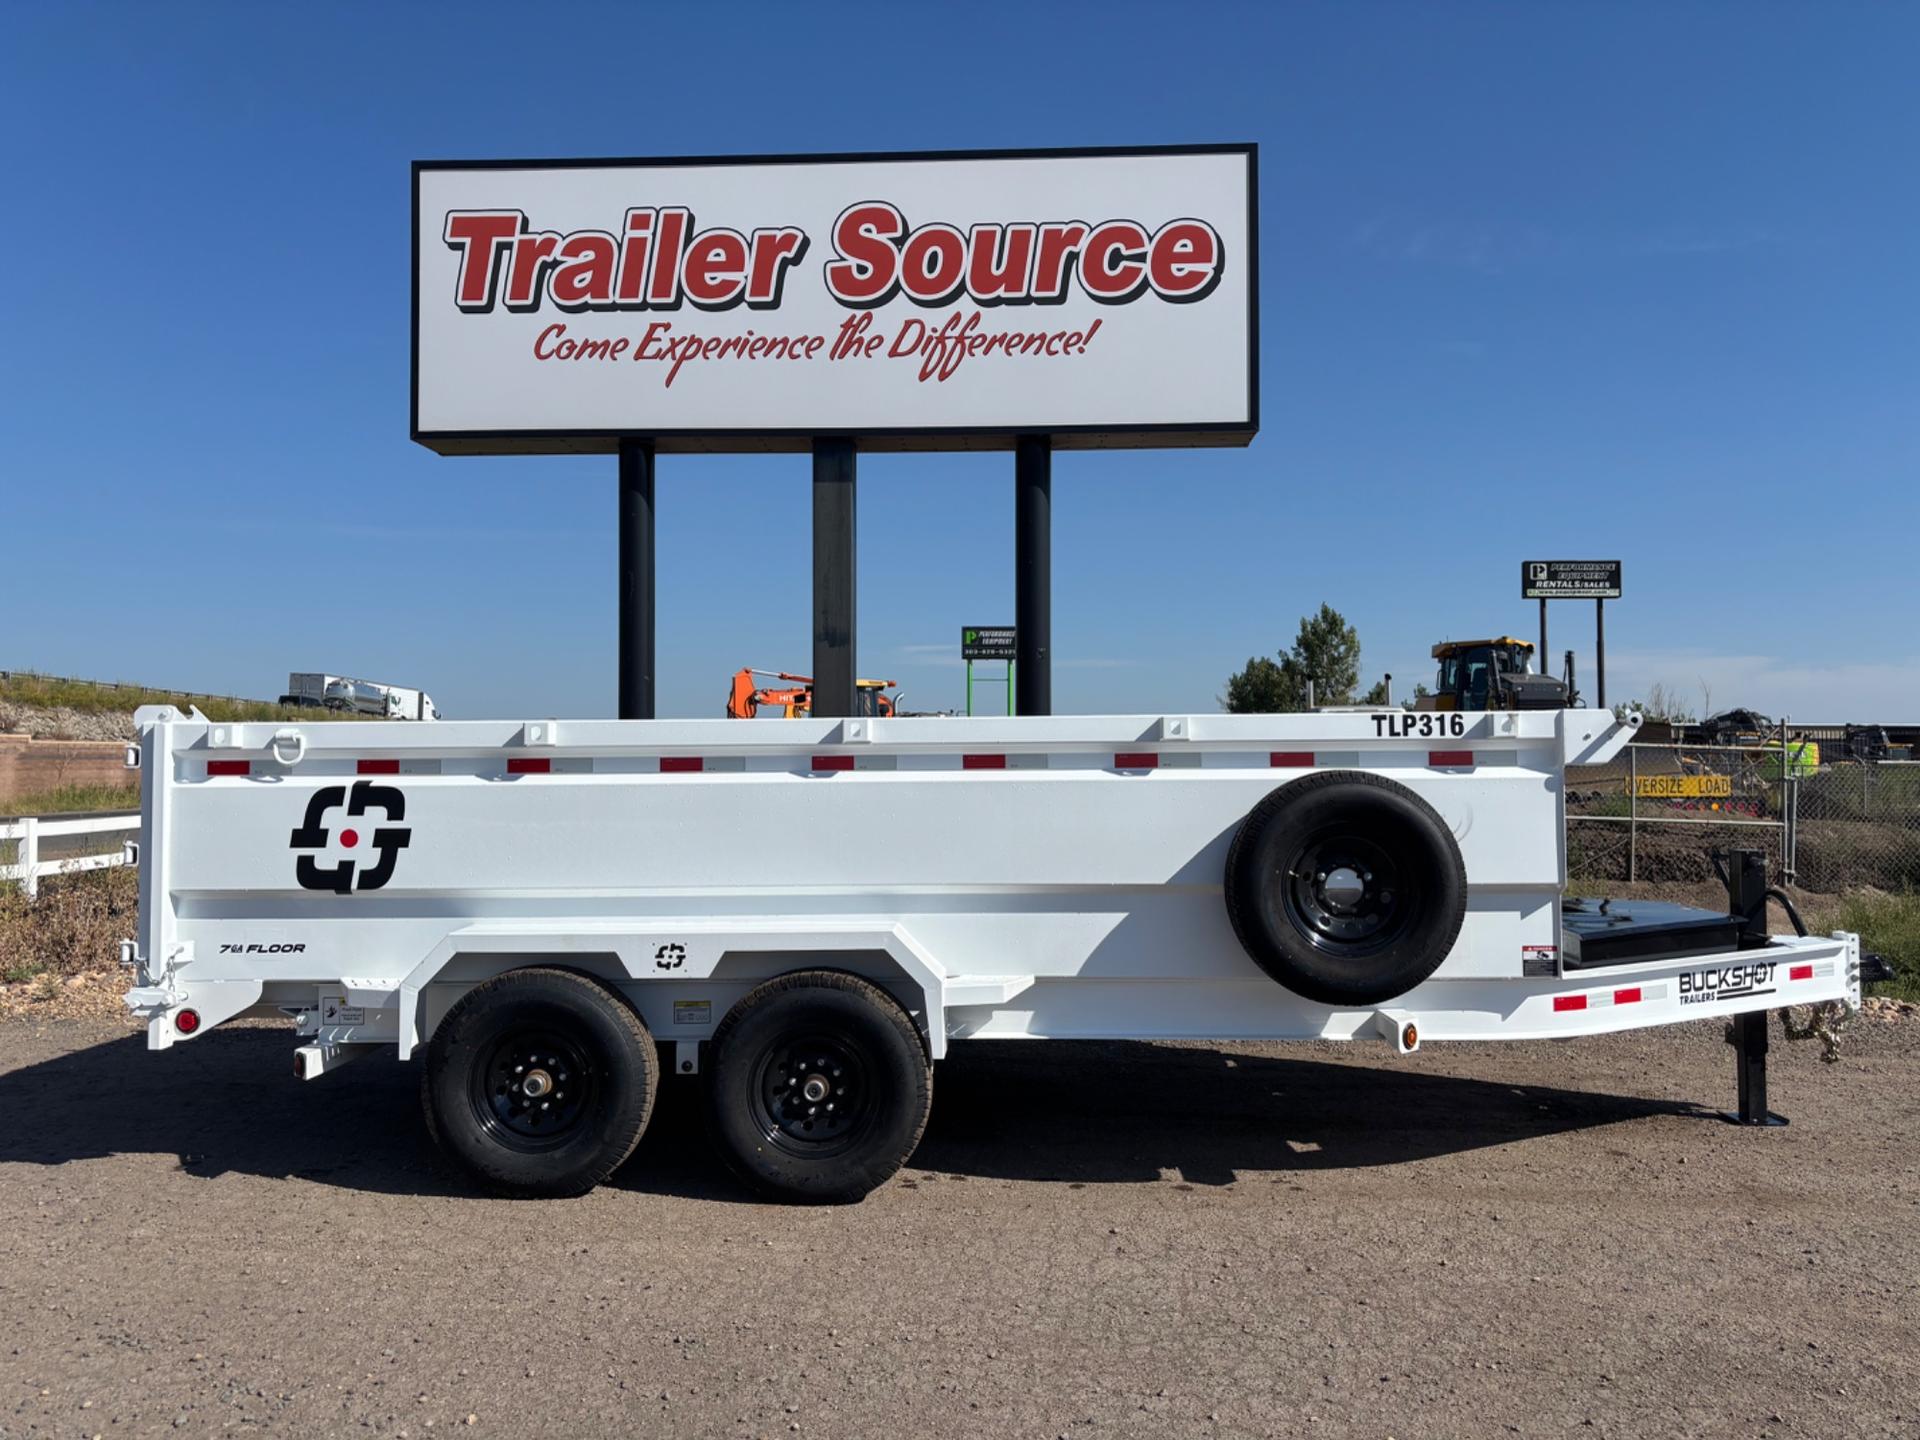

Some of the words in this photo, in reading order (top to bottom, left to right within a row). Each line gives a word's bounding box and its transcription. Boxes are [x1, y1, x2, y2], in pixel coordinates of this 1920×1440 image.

[443, 206, 811, 314] Trailer
[824, 200, 1225, 309] Source
[534, 323, 629, 361] Come
[633, 321, 825, 389] Experience
[829, 311, 883, 361] the
[888, 310, 1103, 382] Difference!
[1371, 713, 1465, 737] TLP316
[1698, 777, 1729, 794] LOAD
[246, 943, 306, 954] FLOOR
[1679, 962, 1777, 994] BUCKSHOT
[1680, 992, 1715, 1006] TRAILERS
